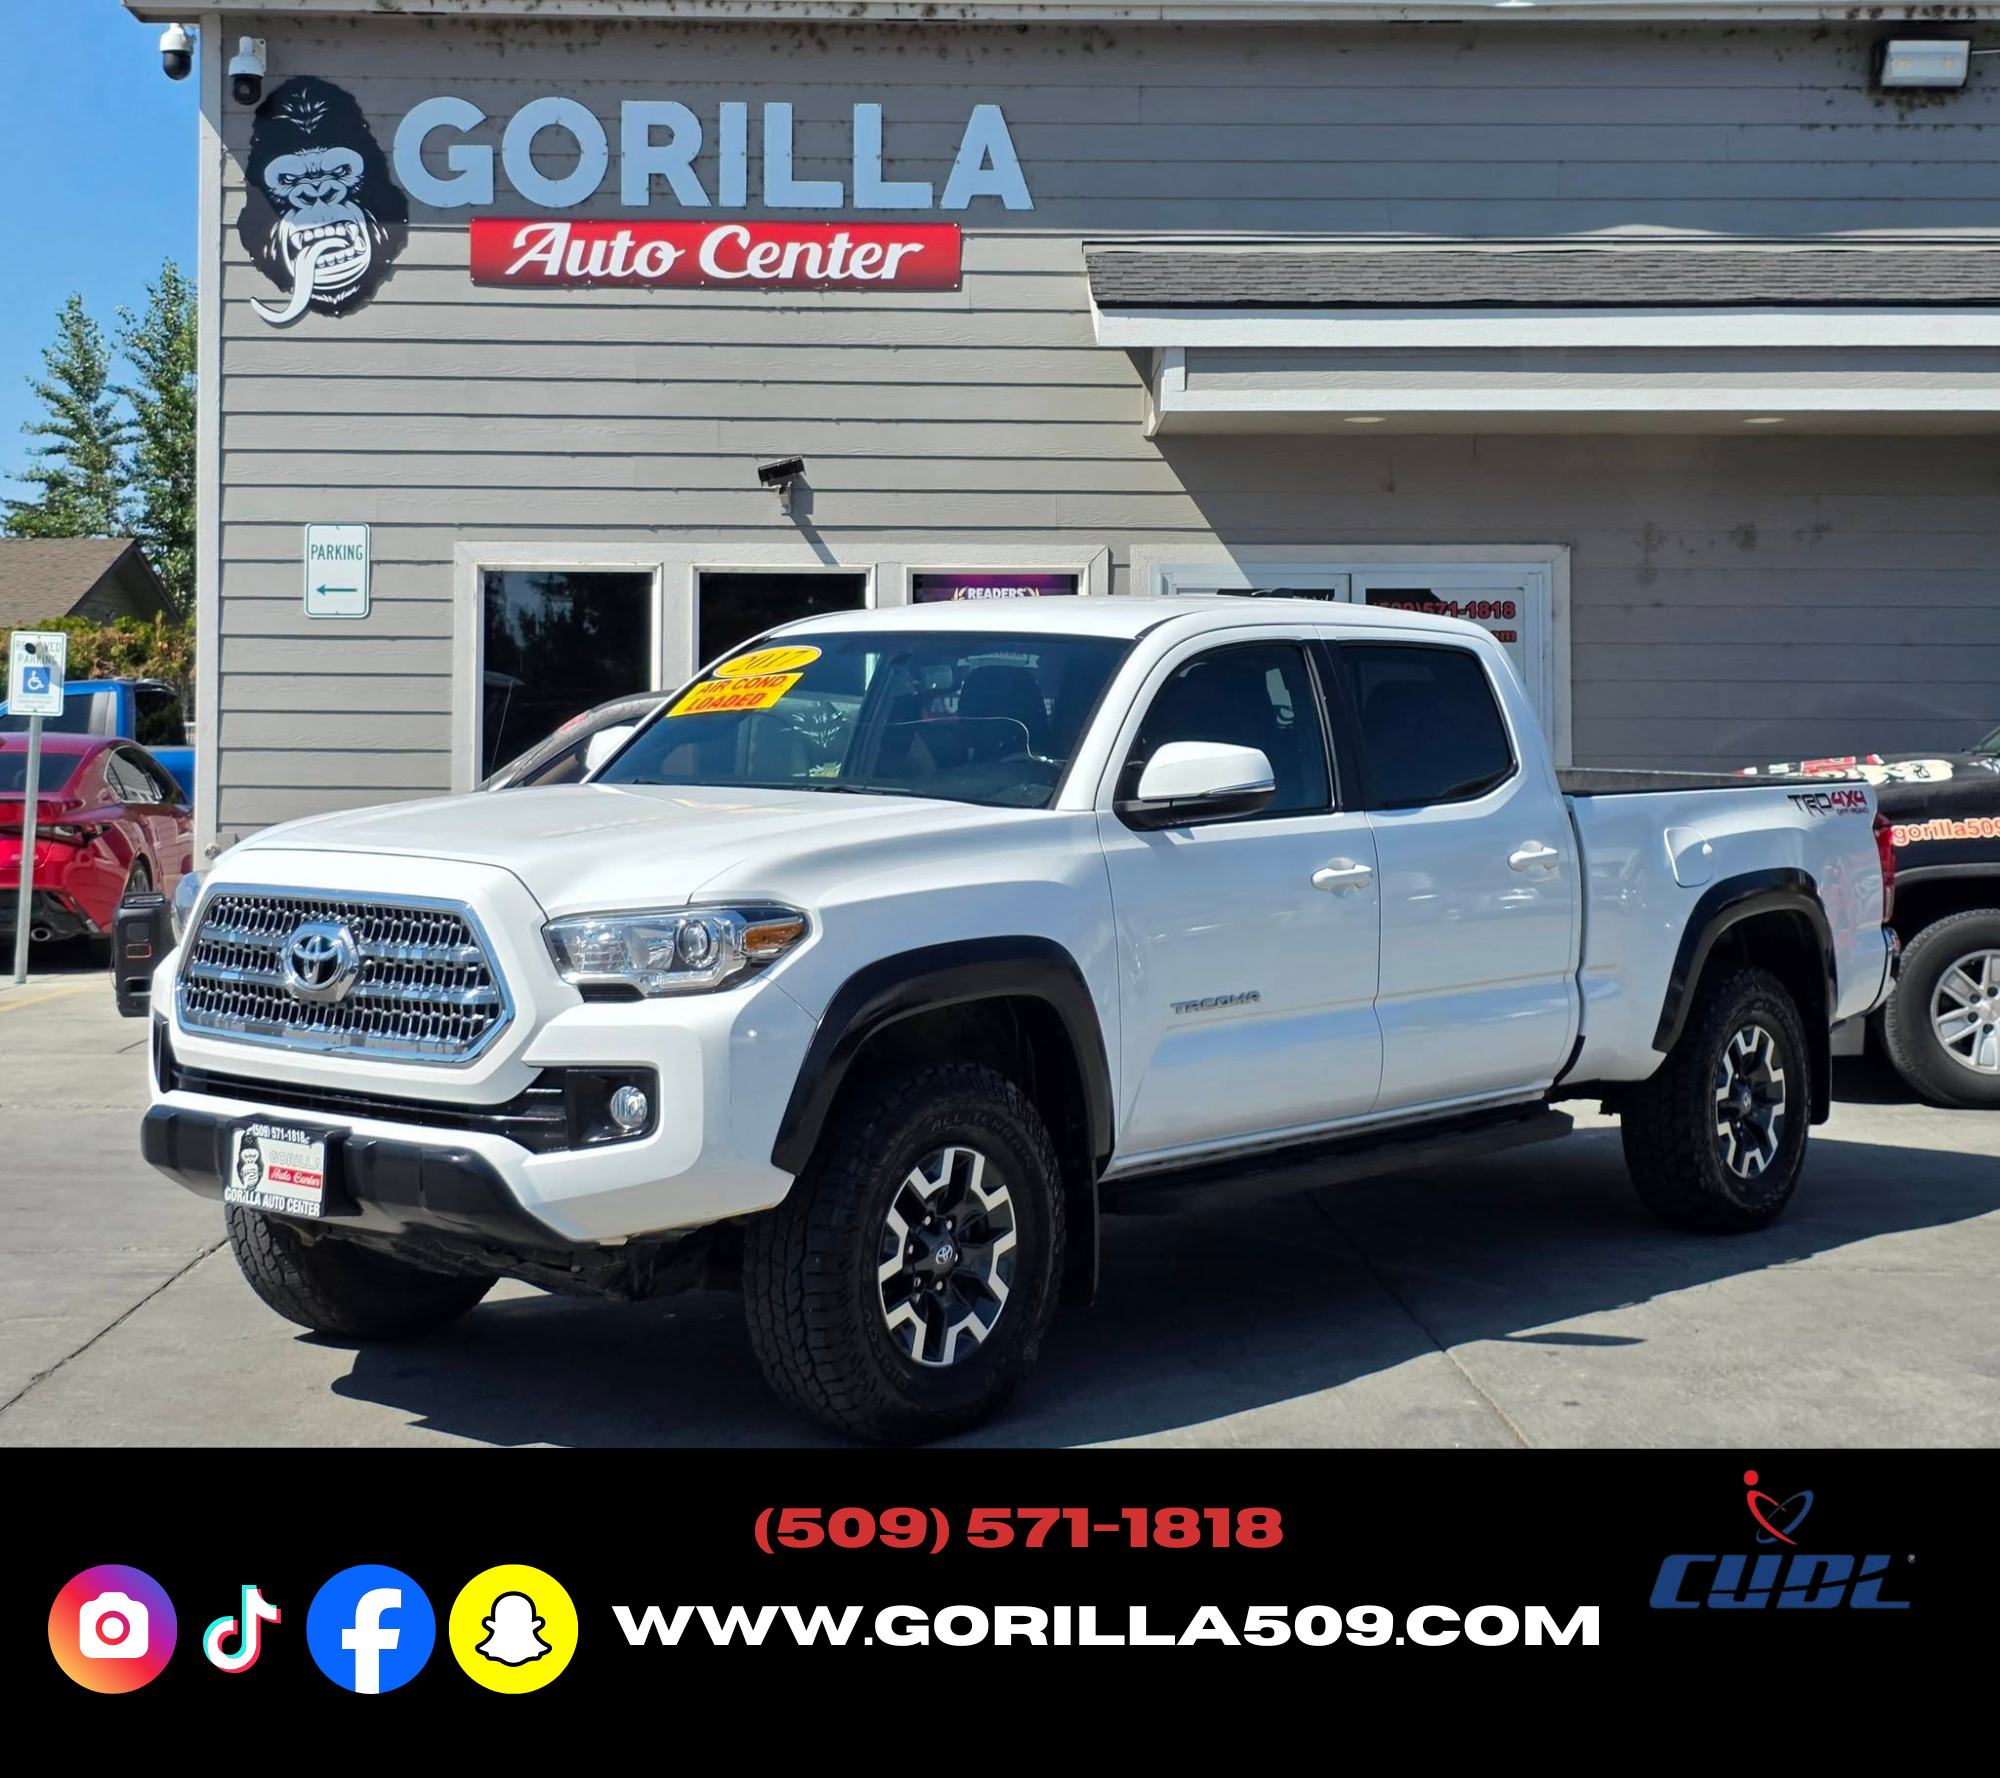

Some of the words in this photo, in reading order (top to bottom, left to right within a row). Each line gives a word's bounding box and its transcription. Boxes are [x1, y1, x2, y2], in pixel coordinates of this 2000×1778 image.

[393, 97, 1034, 211] GORILLA
[505, 222, 685, 277] Auto
[699, 225, 925, 279] Center
[310, 544, 363, 561] PARKING
[15, 641, 61, 652] REVED
[18, 654, 58, 665] PARKING
[726, 650, 811, 674] 2017
[699, 680, 730, 696] AIR
[685, 692, 768, 712] LOADED
[1170, 990, 1260, 1014] TACOMA
[252, 1122, 270, 1138] (509)
[271, 1126, 305, 1144] 571-1818
[268, 1149, 322, 1172] GORILLA
[270, 1167, 291, 1182] Auto
[293, 1171, 321, 1188] Center
[224, 1186, 261, 1206] GORILLA
[262, 1194, 286, 1211] AUTO
[286, 1197, 320, 1217] CENTER
